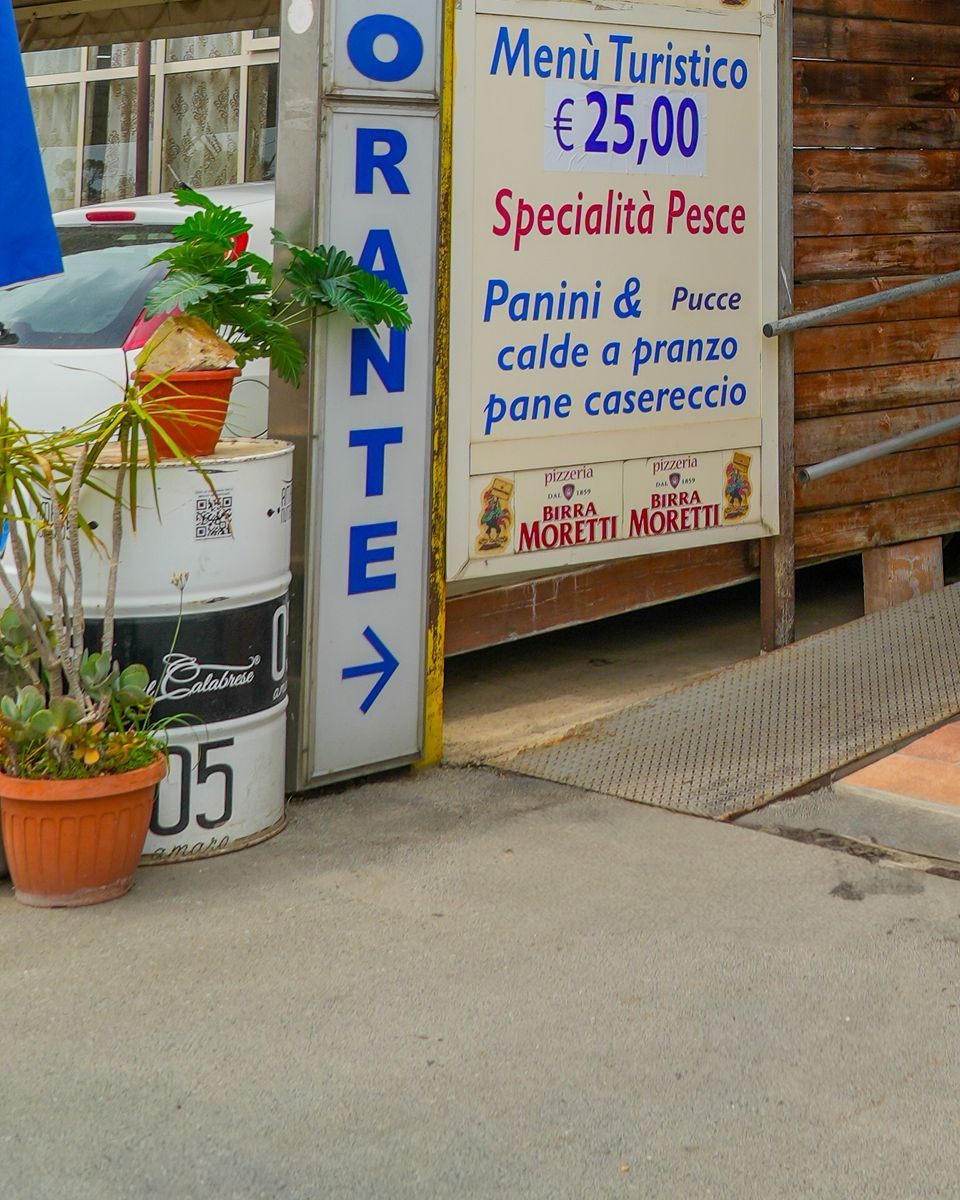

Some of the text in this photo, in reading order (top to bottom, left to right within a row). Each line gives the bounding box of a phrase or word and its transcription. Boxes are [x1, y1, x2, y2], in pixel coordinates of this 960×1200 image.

[489, 26, 748, 89] Menù Turistico
[584, 90, 699, 165] 25,00
[492, 188, 746, 251] Specialità Pesce
[482, 277, 742, 323] Panini & Pucce
[497, 332, 738, 376] calde a pranzo
[482, 375, 747, 435] pane casereccio
[544, 465, 593, 487] pizzeria
[653, 456, 698, 475] pizzeria
[543, 501, 597, 522] BIRRA
[547, 488, 591, 499] DAL 1859
[651, 490, 701, 509] BIRRA
[518, 515, 619, 552] MORETTI
[628, 503, 720, 538] MORETTI
[160, 653, 257, 700] Calabrese
[150, 736, 235, 836] 05
[152, 835, 230, 860] amaro
